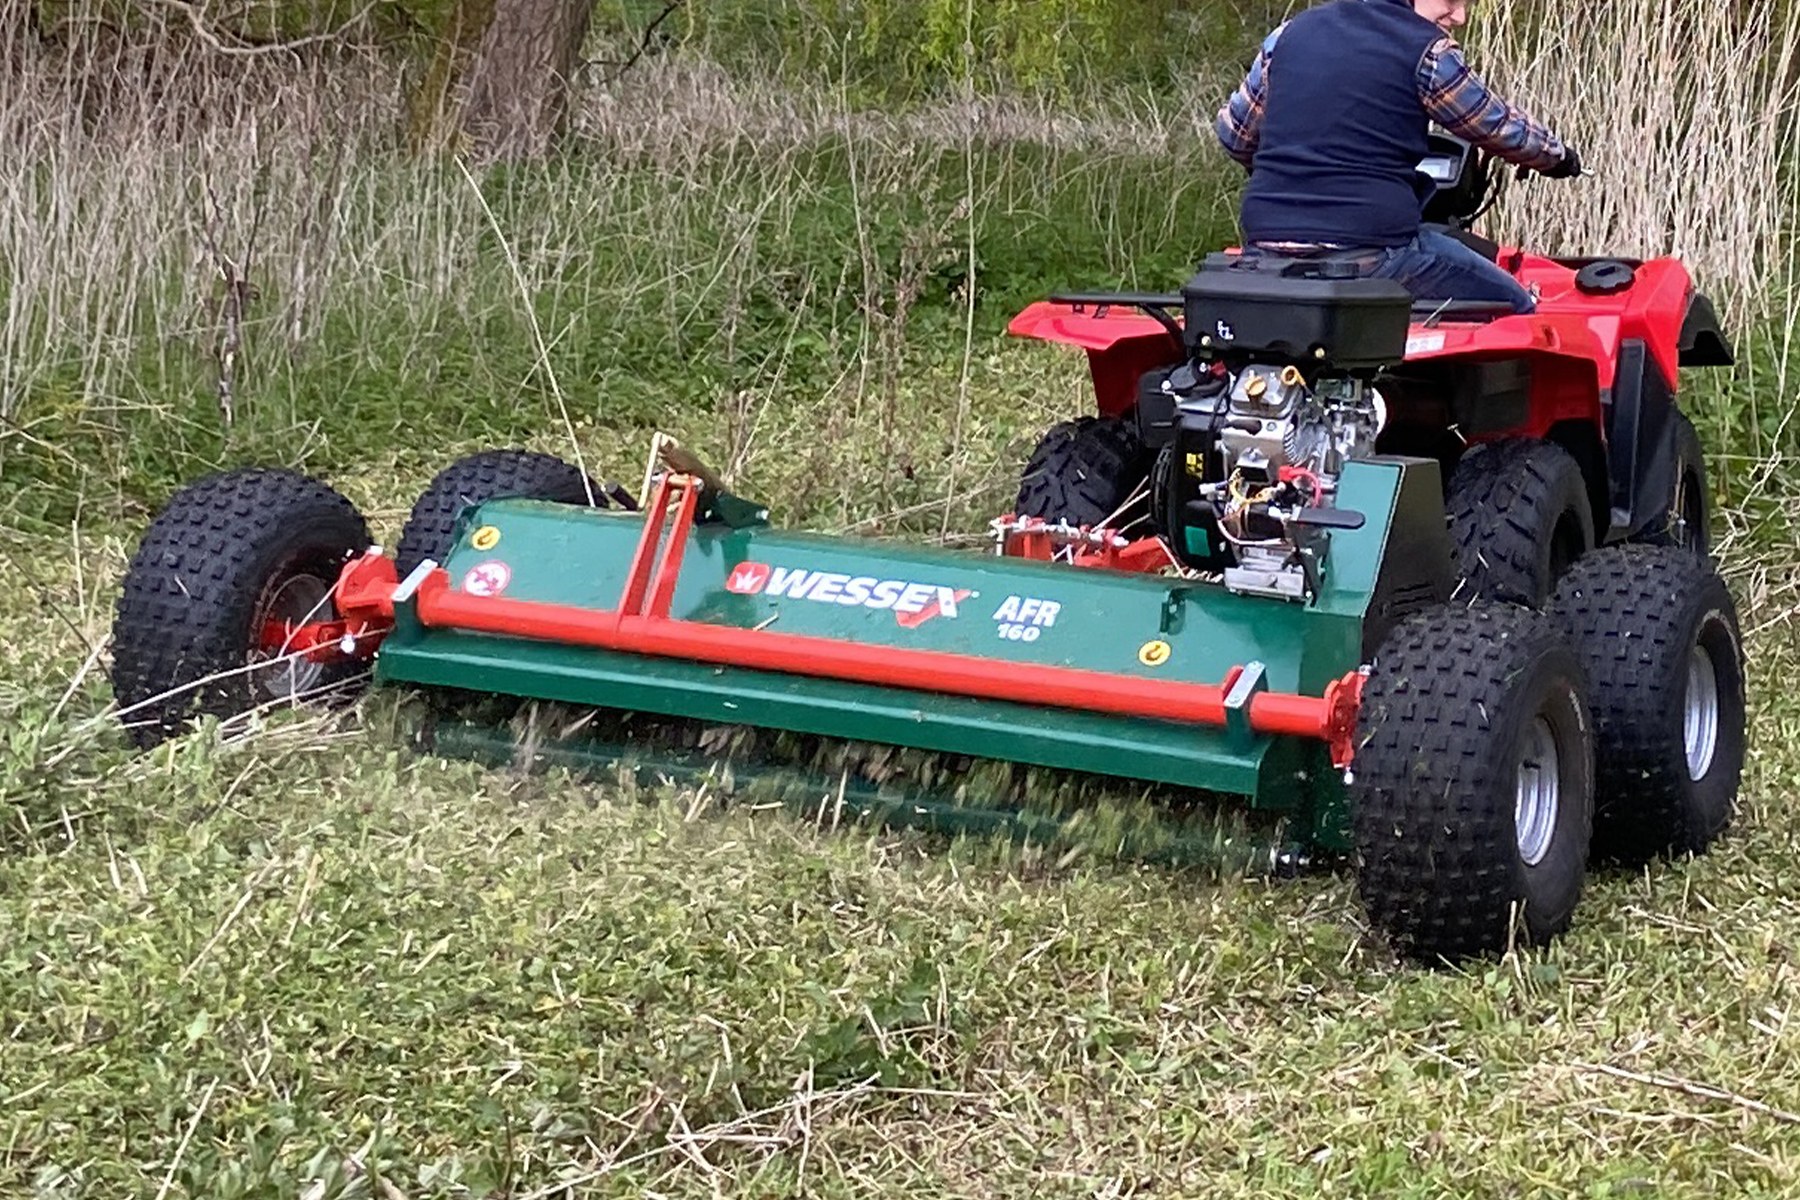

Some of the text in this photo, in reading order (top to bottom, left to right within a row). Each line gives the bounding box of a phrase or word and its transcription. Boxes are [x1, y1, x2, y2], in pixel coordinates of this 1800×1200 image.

[764, 567, 972, 628] WESSEX
[992, 595, 1061, 627] AFR
[997, 623, 1041, 642] 160
